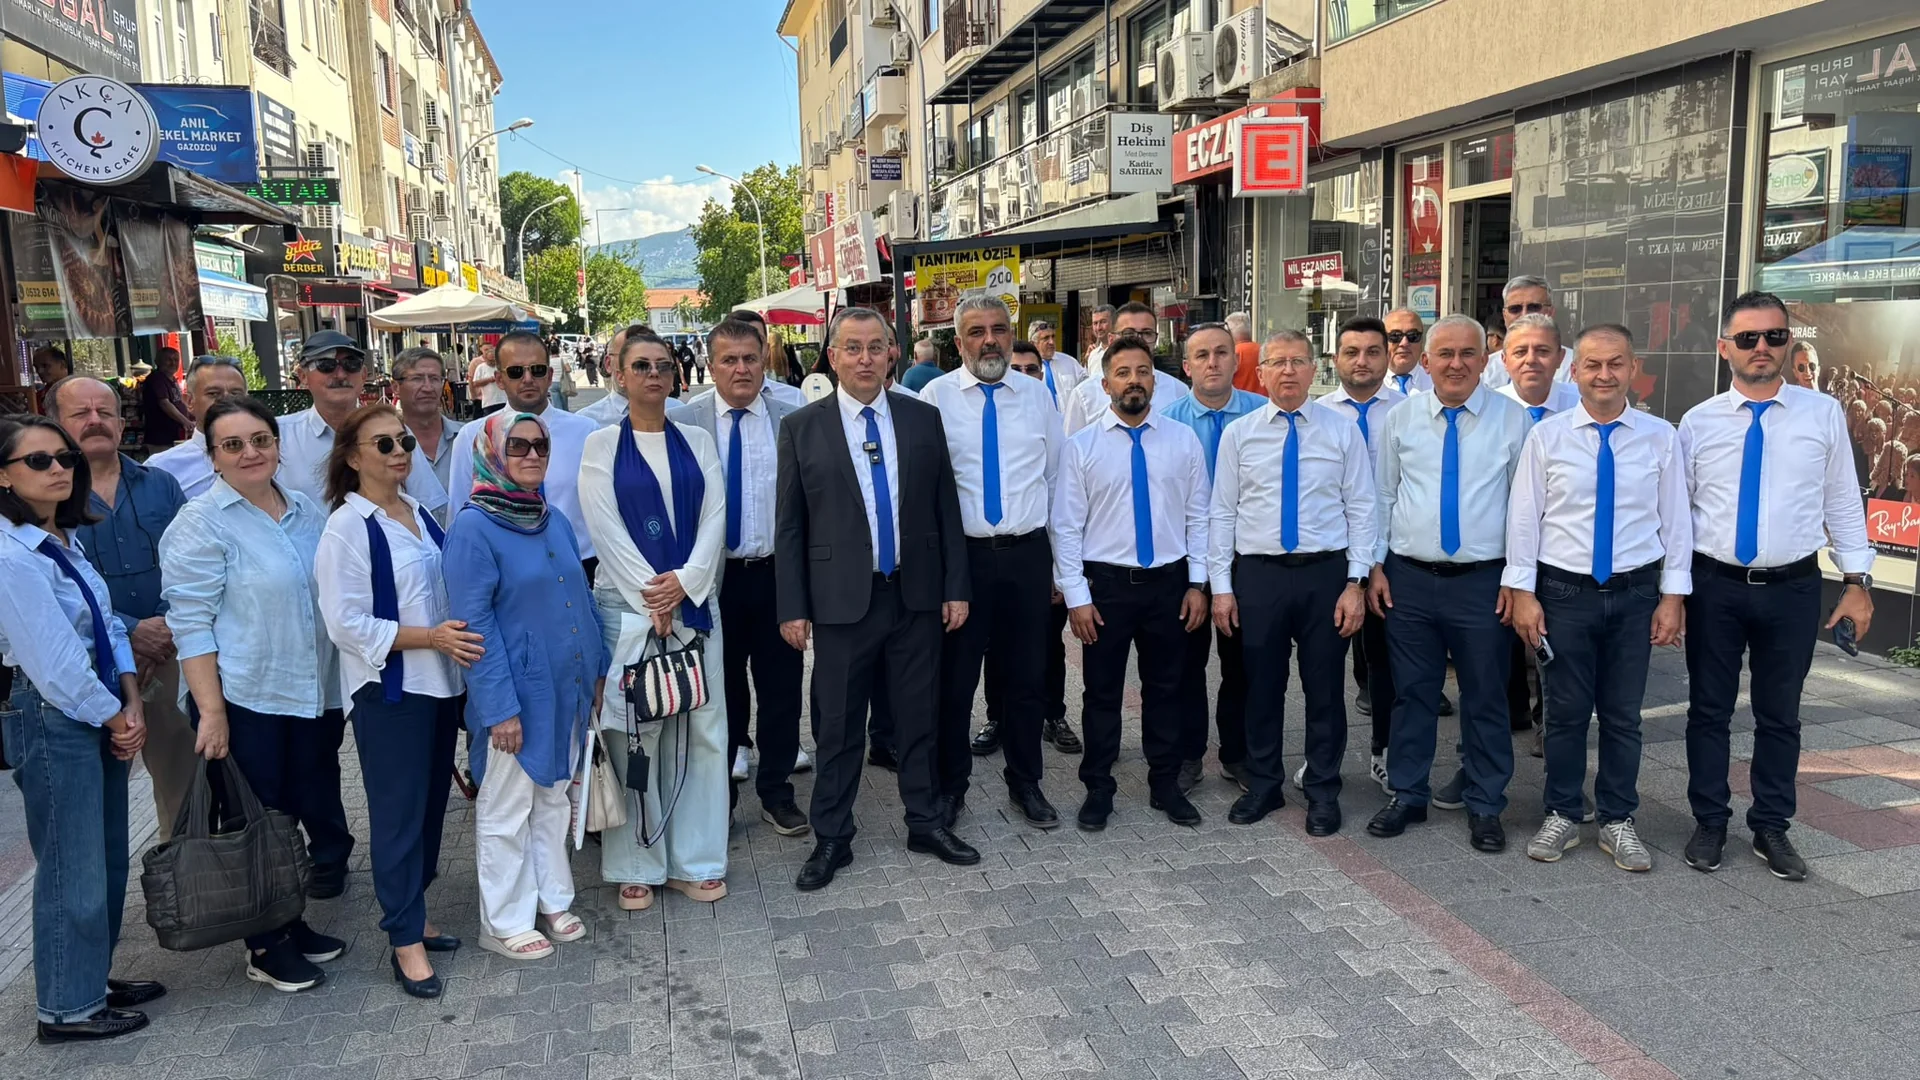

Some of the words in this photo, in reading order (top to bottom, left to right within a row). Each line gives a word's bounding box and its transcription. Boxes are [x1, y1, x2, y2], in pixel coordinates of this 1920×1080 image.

[113, 10, 137, 34] GRUP
[117, 33, 137, 55] YAPI
[58, 83, 133, 115] AKÇA
[180, 117, 210, 129] ANIL
[1131, 122, 1153, 136] Diş
[159, 130, 189, 143] EKEL
[191, 130, 242, 143] MARKET
[1117, 136, 1166, 147] Hekimi
[176, 142, 218, 152] GAZOZCU
[51, 140, 100, 174] KITCHEN
[104, 165, 112, 175] &
[114, 145, 141, 171] CAFE
[1129, 160, 1154, 168] Kadir
[246, 182, 330, 199] AKTAR
[917, 250, 980, 267] TANITIMA
[982, 247, 1015, 261] ÖZEL
[283, 263, 325, 273] BERBER
[1288, 261, 1300, 276] NİL
[1300, 256, 1338, 274] ECZANESİ
